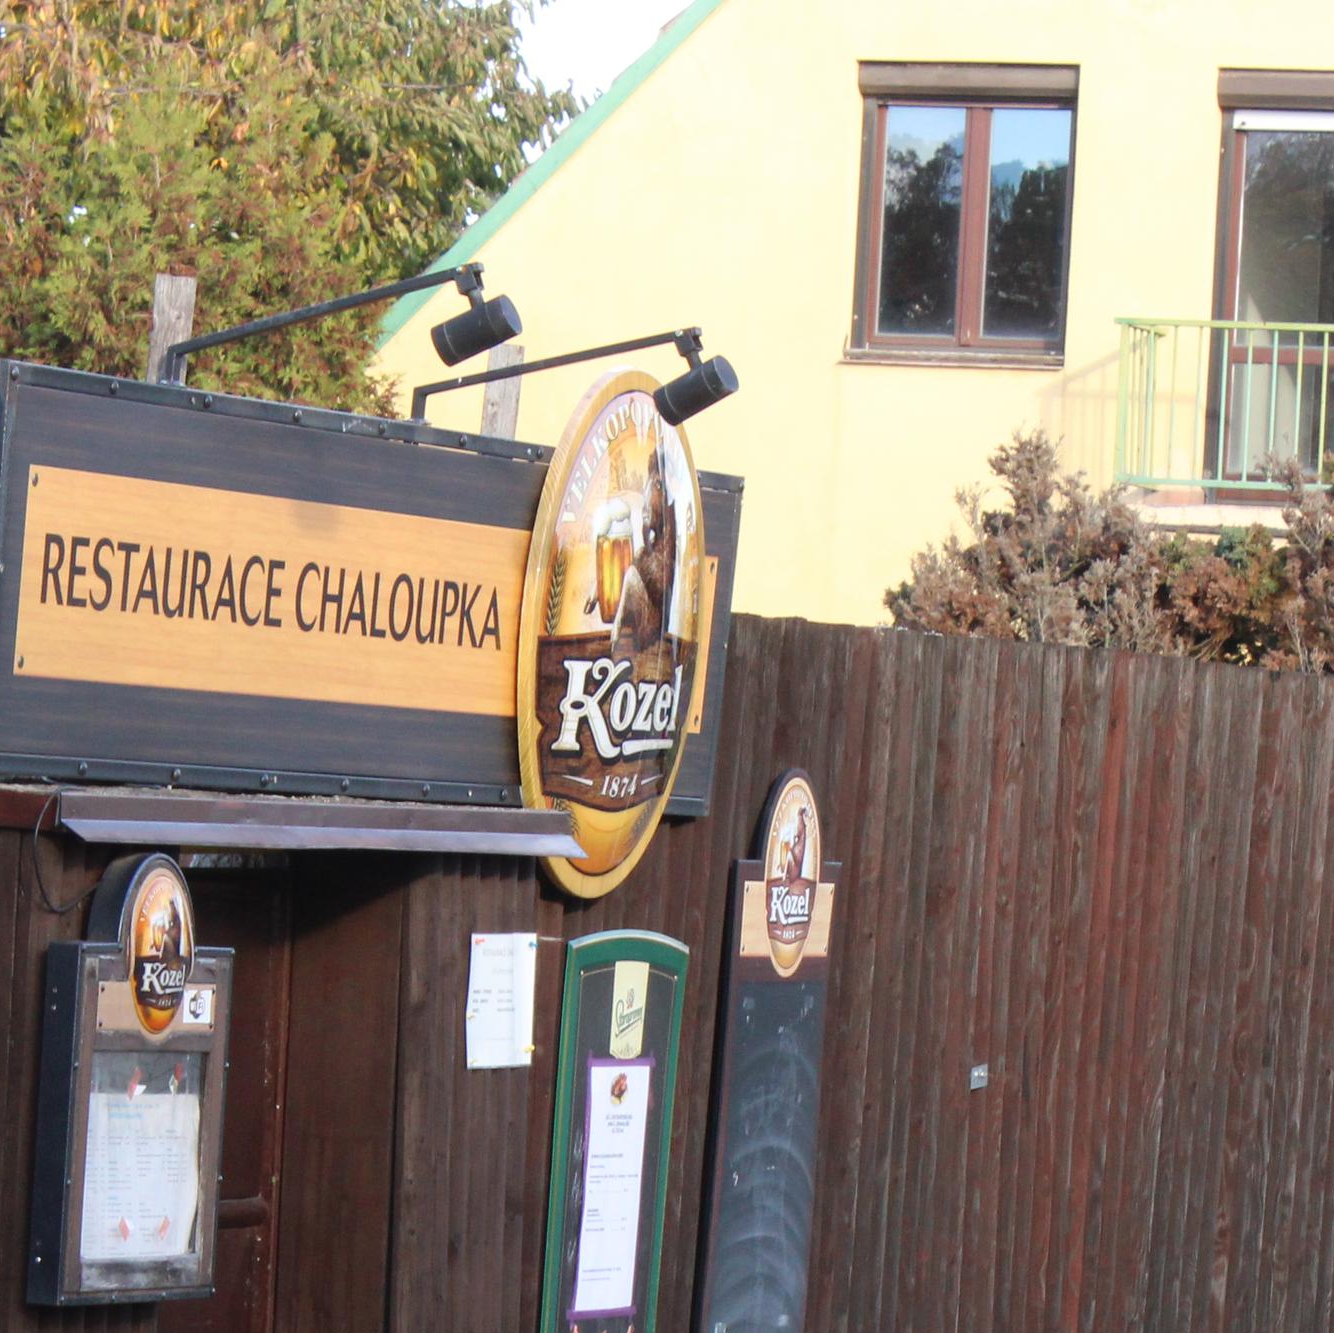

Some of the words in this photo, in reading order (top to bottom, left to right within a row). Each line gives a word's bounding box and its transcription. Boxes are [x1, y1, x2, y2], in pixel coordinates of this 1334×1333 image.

[40, 532, 285, 629] RESTAURACE
[295, 560, 503, 652] CHALOUPKA
[551, 658, 684, 759] Kozel
[600, 774, 638, 798] 1874
[769, 886, 811, 925] Kozel
[141, 962, 186, 995] Kozel
